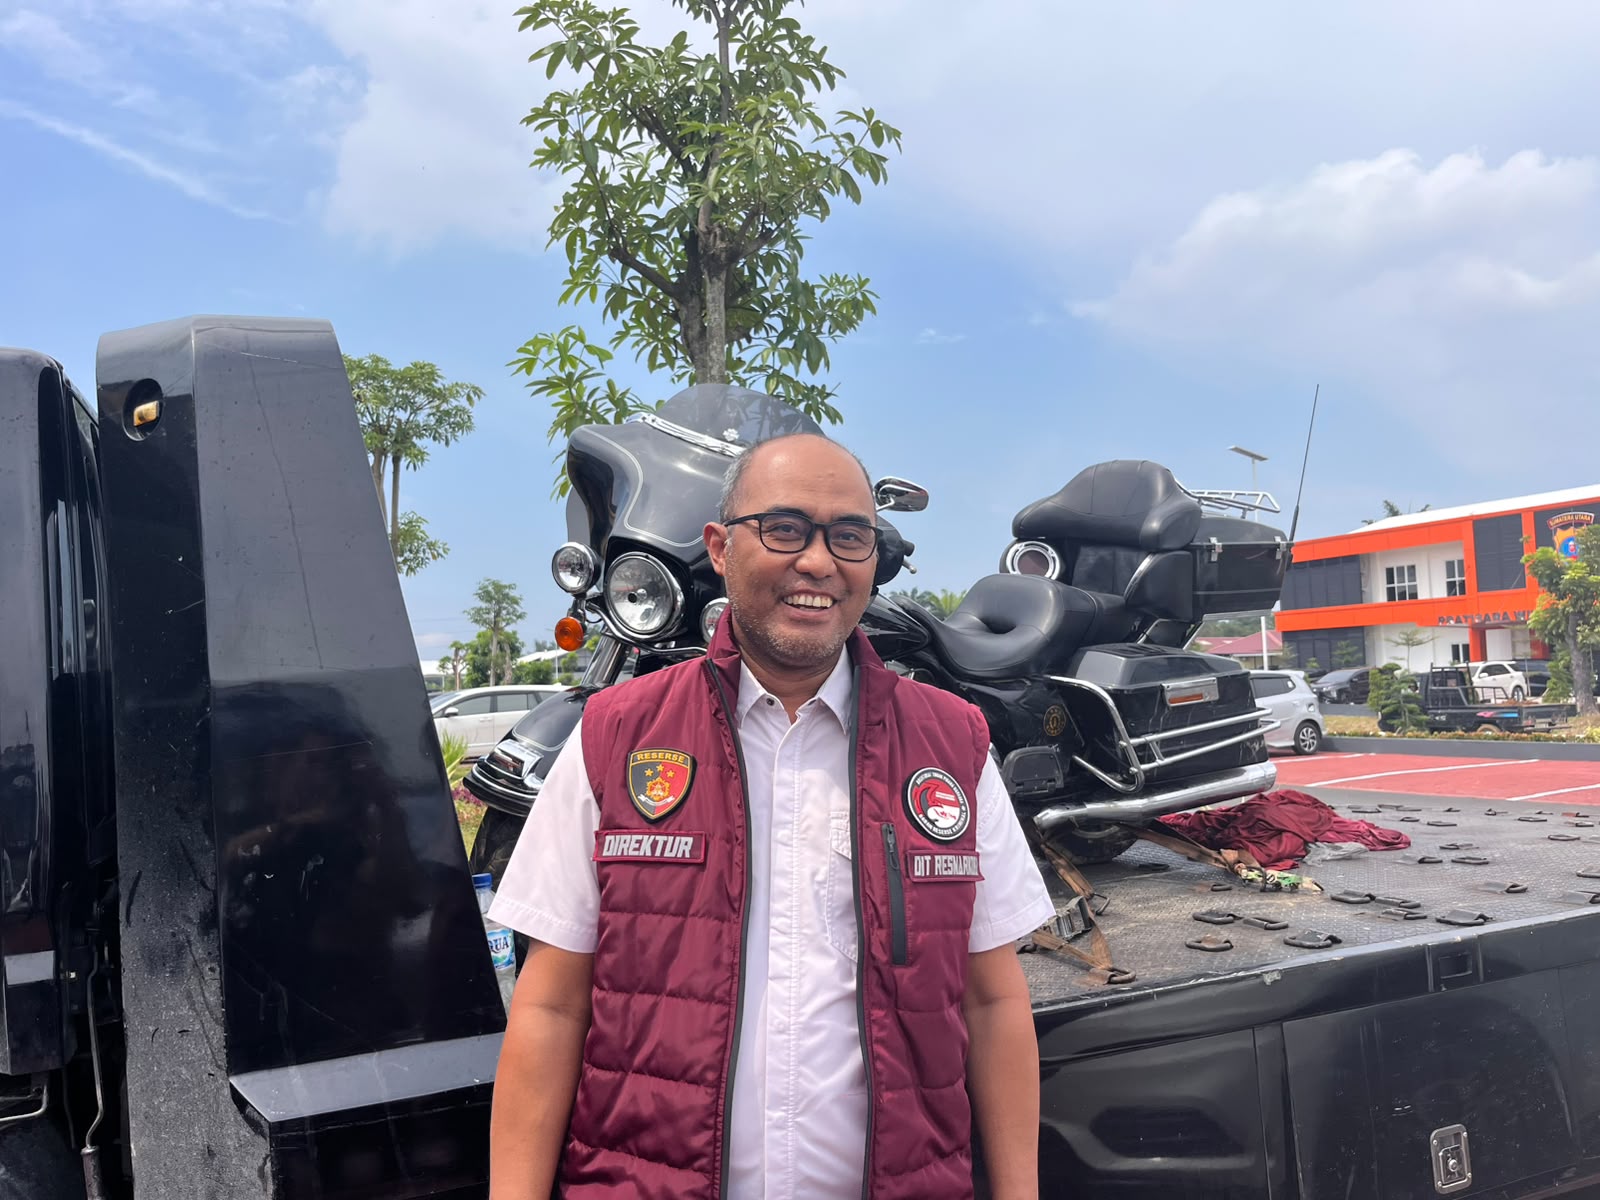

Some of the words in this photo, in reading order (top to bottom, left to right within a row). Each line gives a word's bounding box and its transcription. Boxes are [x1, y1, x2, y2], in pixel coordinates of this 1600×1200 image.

[1574, 513, 1591, 521] UTARA
[636, 752, 685, 763] RESERSE
[602, 834, 694, 858] DIREKTUR
[914, 855, 931, 877] DIT
[487, 936, 510, 954] QUA
